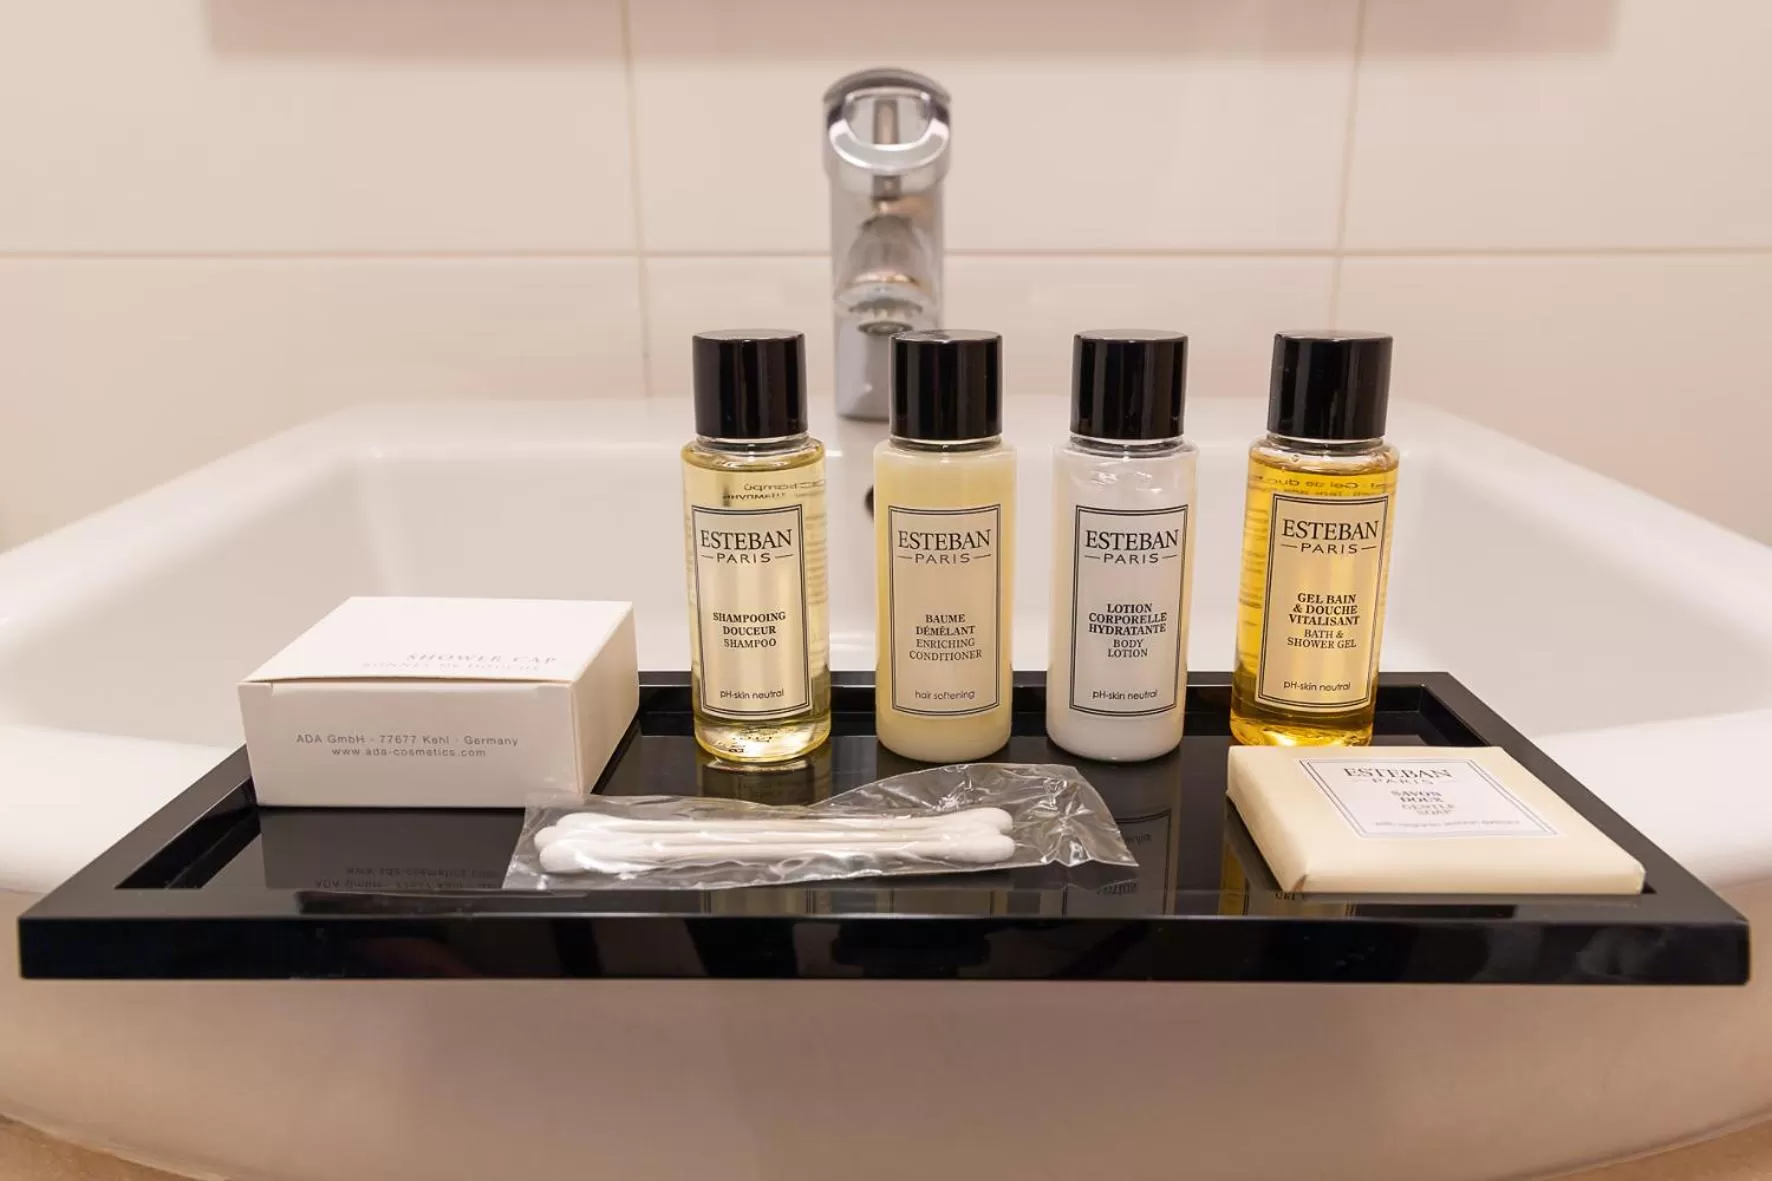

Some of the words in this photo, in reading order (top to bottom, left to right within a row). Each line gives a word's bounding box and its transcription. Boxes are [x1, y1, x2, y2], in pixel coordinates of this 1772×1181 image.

[1282, 518, 1380, 542] ESTEBAN
[700, 528, 793, 551] ESTEBAN
[898, 528, 992, 552] ESTEBAN
[1085, 528, 1180, 552] ESTEBAN
[1301, 542, 1358, 554] PARIS
[717, 552, 771, 563] PARIS
[915, 553, 970, 564] PARIS
[1104, 553, 1159, 564] PARIS
[1297, 592, 1324, 605] GEL
[1327, 593, 1356, 605] BAIN
[1107, 603, 1152, 614] LOTION
[1293, 604, 1302, 613] &
[1305, 604, 1358, 615] DOUCHE
[712, 611, 786, 623] SHAMPOOING
[925, 614, 966, 624] BAUME
[1088, 612, 1167, 624] CORPORELLE
[1288, 613, 1360, 626] VITALISANT
[723, 625, 777, 635] DOUCEUR
[916, 624, 975, 636] DÉMÊLANT
[1088, 623, 1167, 635] HYDRATANTE
[1304, 629, 1333, 640] BATH
[1336, 629, 1344, 639] &
[724, 637, 777, 648] SHAMPOO
[916, 637, 975, 648] ENRICHING
[1113, 639, 1143, 649] BODY
[1287, 637, 1335, 649] SHOWER
[1337, 640, 1357, 649] GEL
[909, 649, 982, 661] CONDITIONER
[1107, 648, 1148, 659] LOTION
[1283, 680, 1317, 691] pH-skin
[1319, 682, 1351, 691] neutral
[720, 689, 750, 700] pH-skin
[752, 690, 784, 700] neutral
[915, 689, 930, 699] hair
[933, 689, 975, 700] softening
[1092, 689, 1126, 701] pH-skin
[1127, 689, 1158, 700] neutral
[296, 734, 322, 744] ADA
[327, 734, 365, 744] GmbH
[422, 735, 450, 745] Kehl
[463, 735, 518, 747] Germany
[1344, 767, 1452, 778] ESTEBAN
